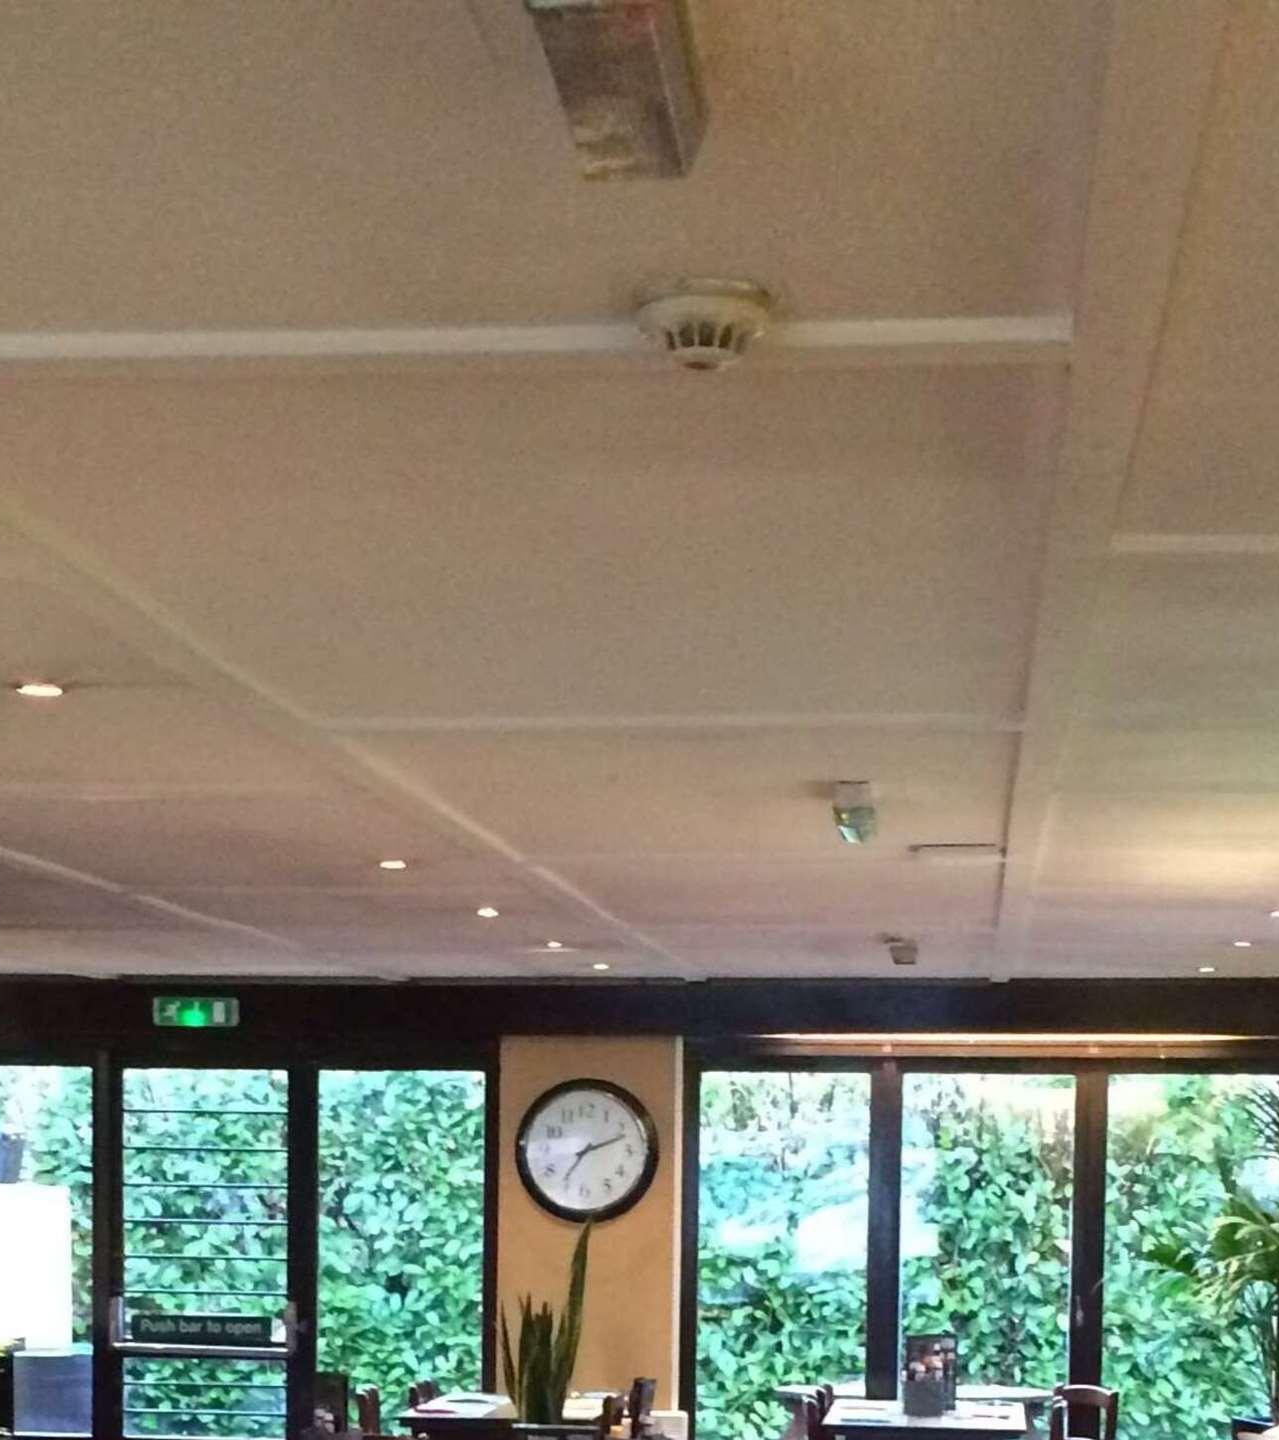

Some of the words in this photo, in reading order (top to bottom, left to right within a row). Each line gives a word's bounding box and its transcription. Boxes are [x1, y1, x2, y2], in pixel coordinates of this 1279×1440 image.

[561, 1109, 574, 1124] 11
[579, 1103, 596, 1119] 12
[546, 1126, 563, 1140] 10
[139, 1318, 175, 1333] Push
[179, 1319, 202, 1333] bar
[206, 1320, 220, 1333] to
[225, 1322, 262, 1336] open
